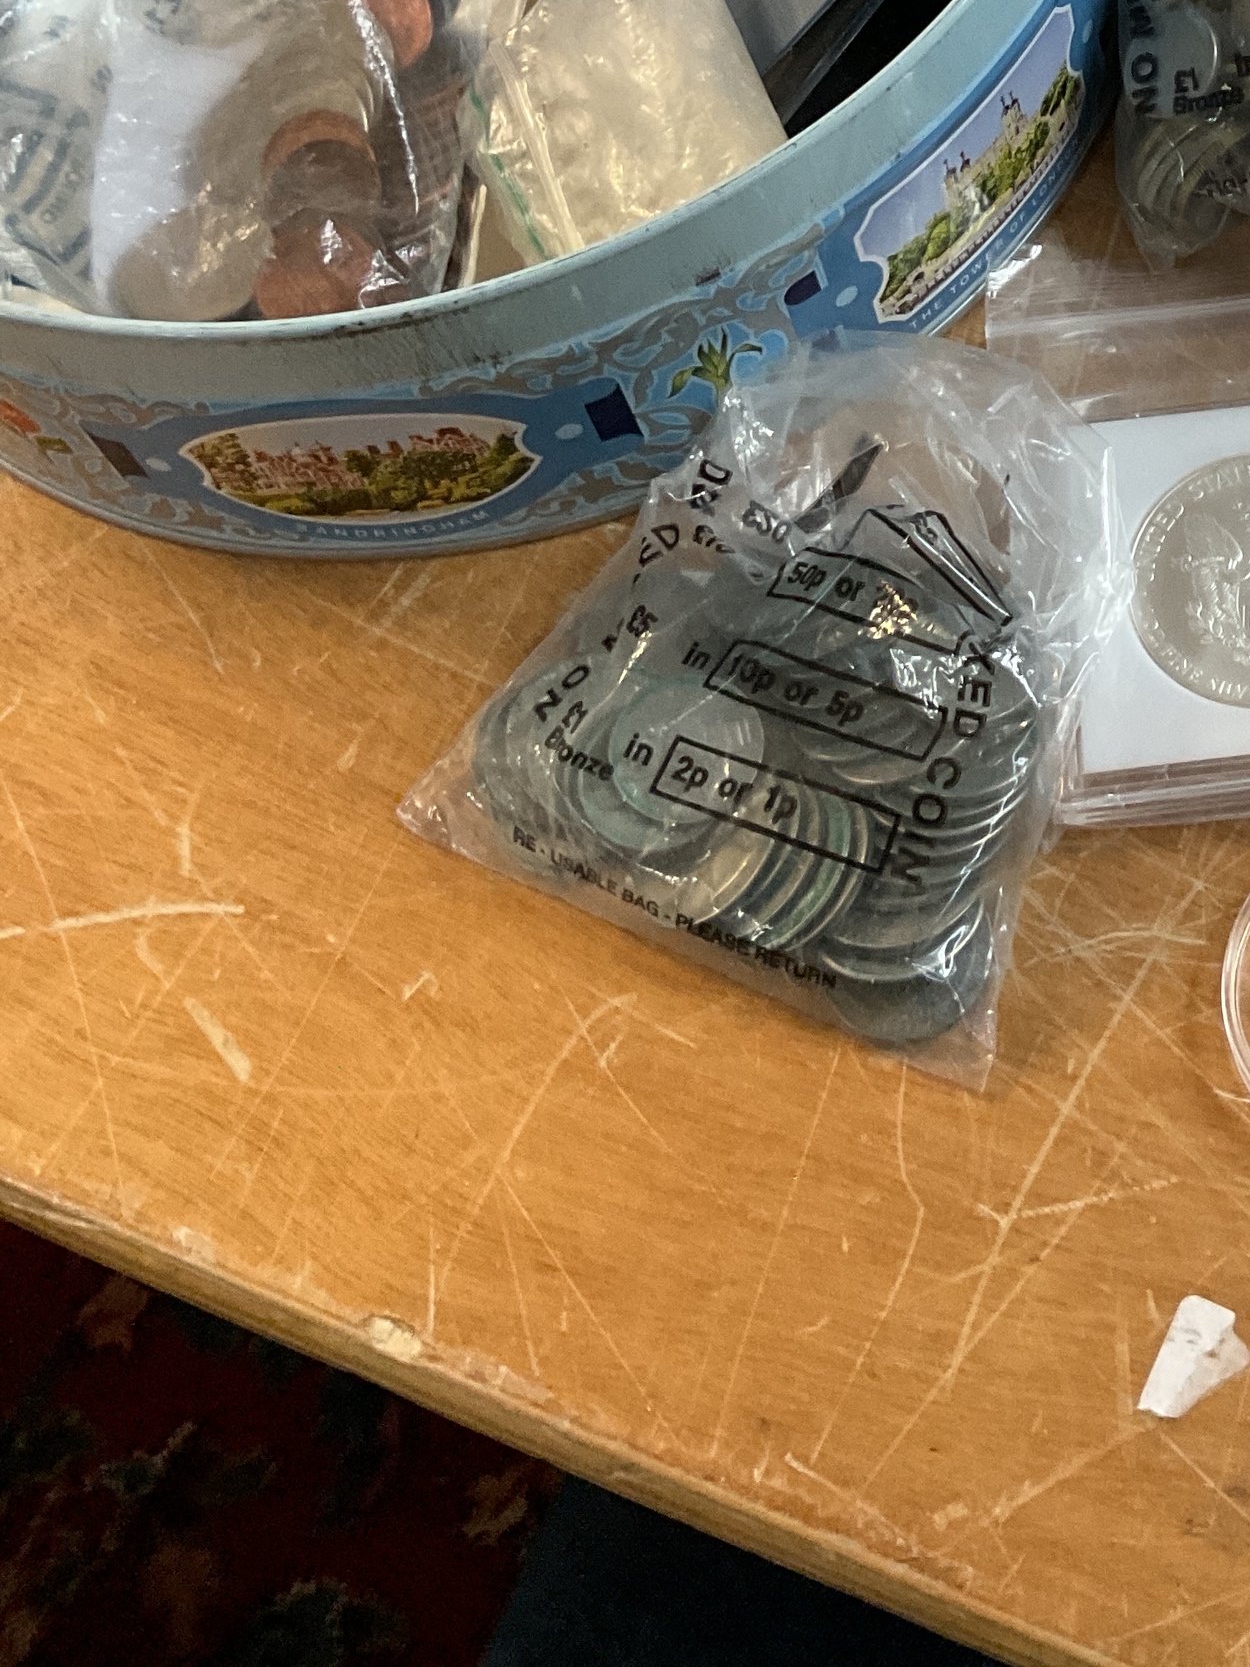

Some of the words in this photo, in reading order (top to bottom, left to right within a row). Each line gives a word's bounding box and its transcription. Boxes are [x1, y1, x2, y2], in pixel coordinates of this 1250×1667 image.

[1131, 52, 1159, 116] NO
[910, 299, 943, 329] THE
[787, 562, 827, 591] 50p
[835, 576, 866, 601] or
[681, 641, 711, 670] in
[730, 653, 777, 694] 10p
[784, 682, 819, 708] or
[826, 689, 864, 727] 5p
[545, 725, 614, 782] Bronze
[623, 733, 654, 767] in
[670, 755, 709, 793] 2p
[717, 779, 753, 803] or
[763, 784, 797, 825] 1p
[890, 757, 962, 885] COIN
[550, 847, 617, 896] USABLE
[621, 888, 659, 917] BAG
[675, 912, 750, 957] PLEASE
[754, 944, 837, 989] RETURN
